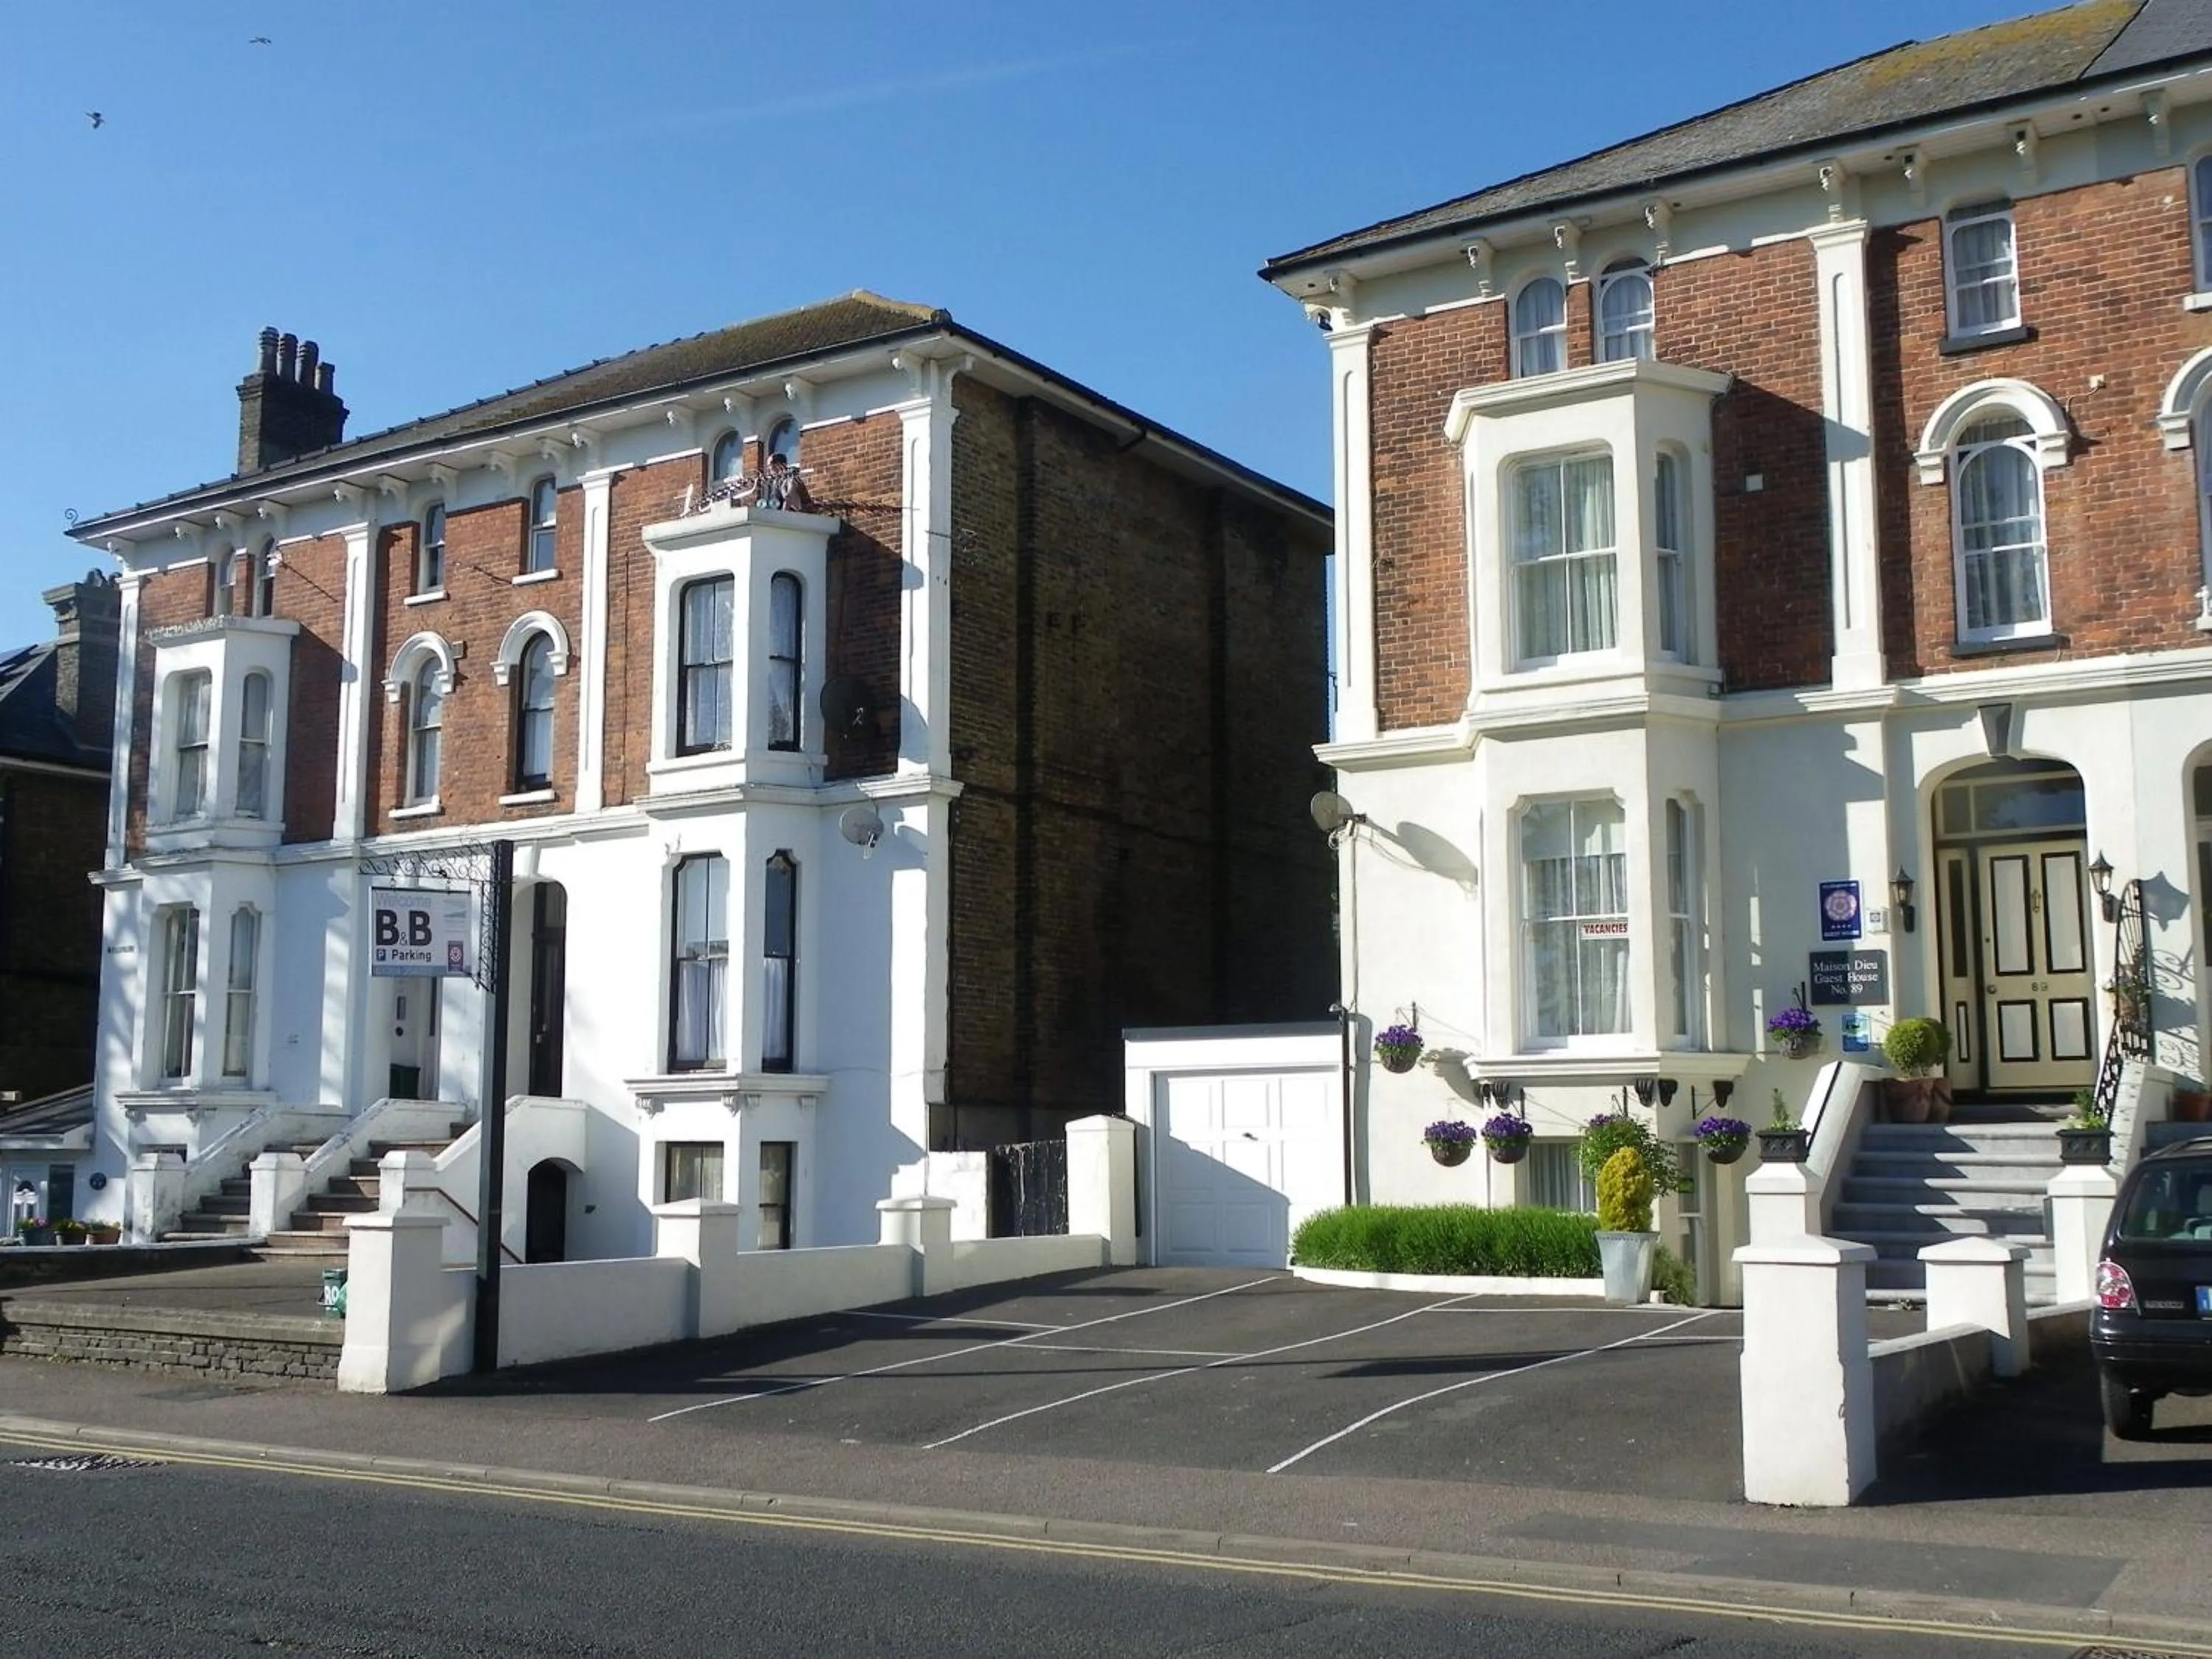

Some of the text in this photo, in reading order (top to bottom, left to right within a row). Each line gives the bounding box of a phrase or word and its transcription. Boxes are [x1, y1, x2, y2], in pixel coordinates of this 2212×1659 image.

[1584, 923, 1627, 934] VACANCIES
[392, 949, 431, 962] Parking
[1814, 959, 1878, 972] Maison Dieu
[1815, 972, 1878, 984] Guest House
[1850, 983, 1863, 994] 89
